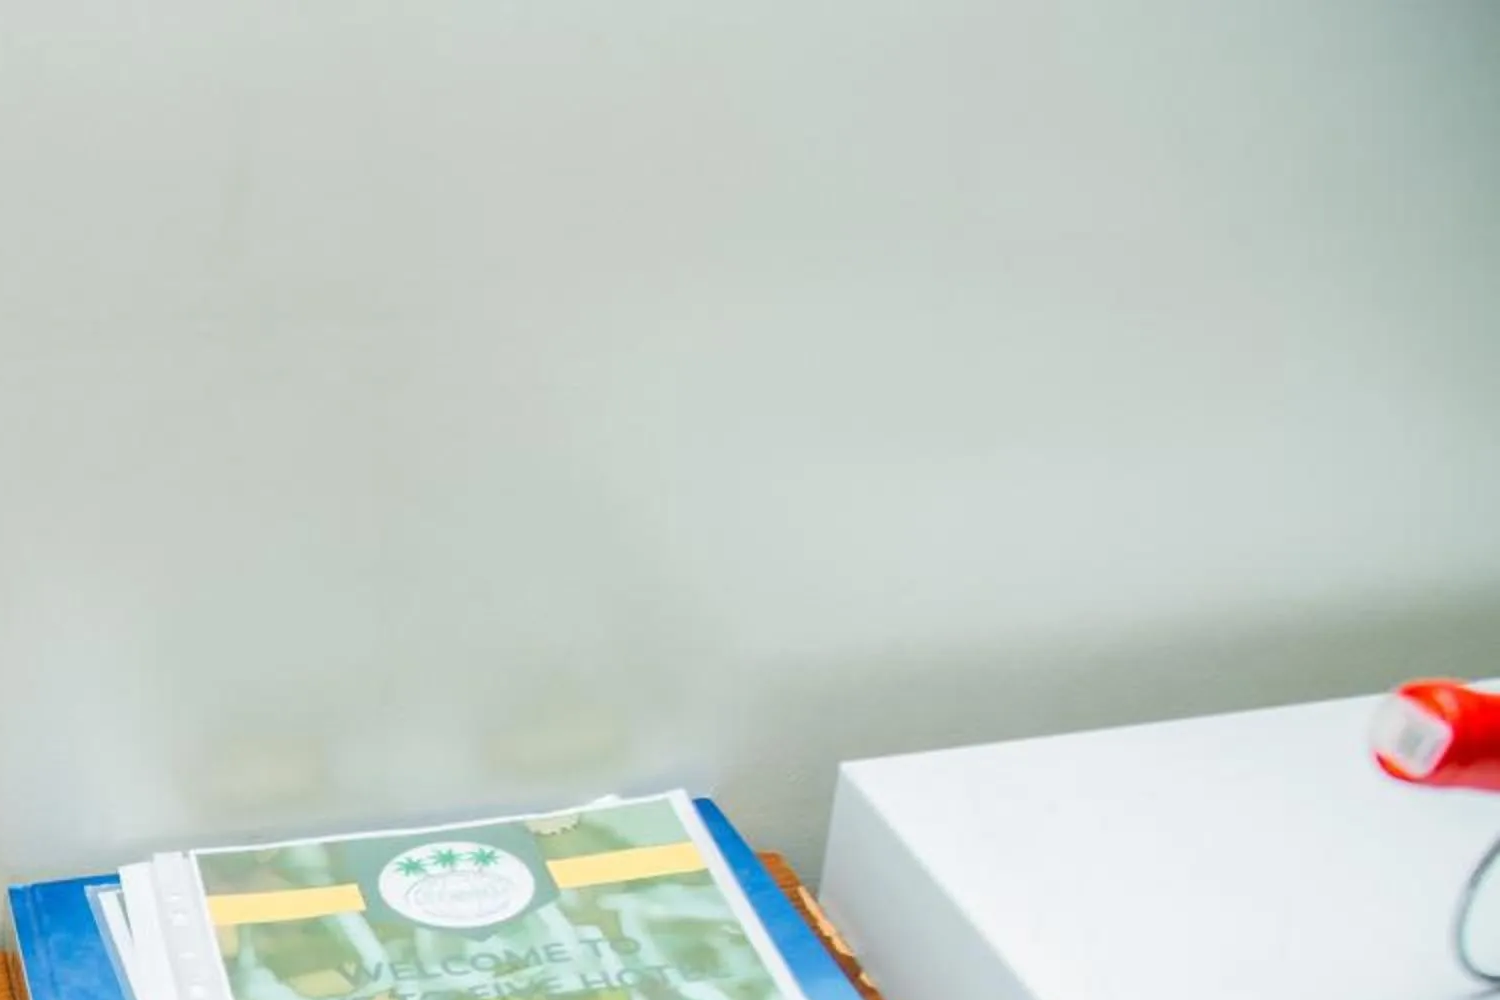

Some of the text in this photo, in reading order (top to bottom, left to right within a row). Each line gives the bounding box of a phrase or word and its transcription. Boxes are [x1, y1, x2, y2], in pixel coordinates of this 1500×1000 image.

[340, 937, 642, 984] WELCOME TO
[468, 968, 564, 1000] FIVE
